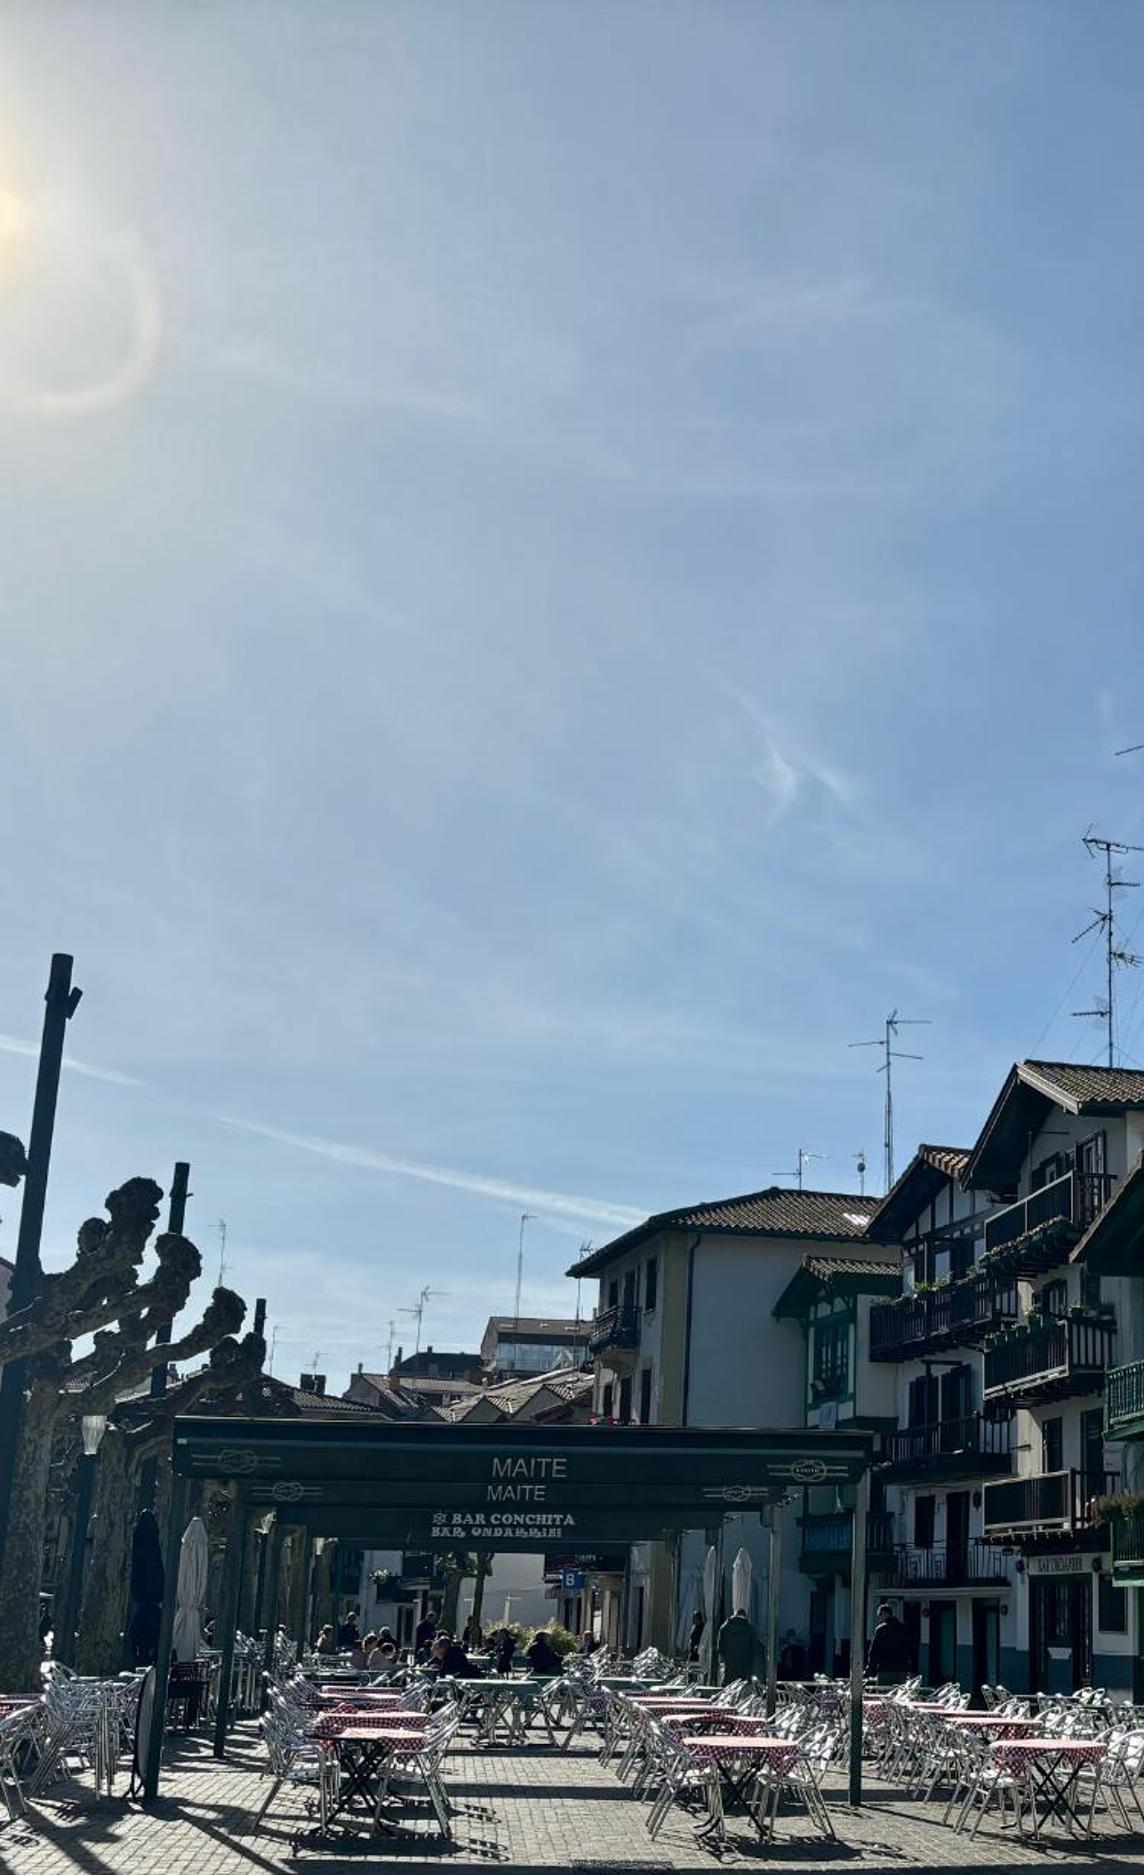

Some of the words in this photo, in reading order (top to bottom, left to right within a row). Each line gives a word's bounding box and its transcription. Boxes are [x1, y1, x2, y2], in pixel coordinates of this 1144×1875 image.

[492, 1457, 567, 1478] MAITE
[487, 1485, 547, 1501] MAITE
[451, 1513, 486, 1526] BAR
[490, 1512, 576, 1526] CONCHITA
